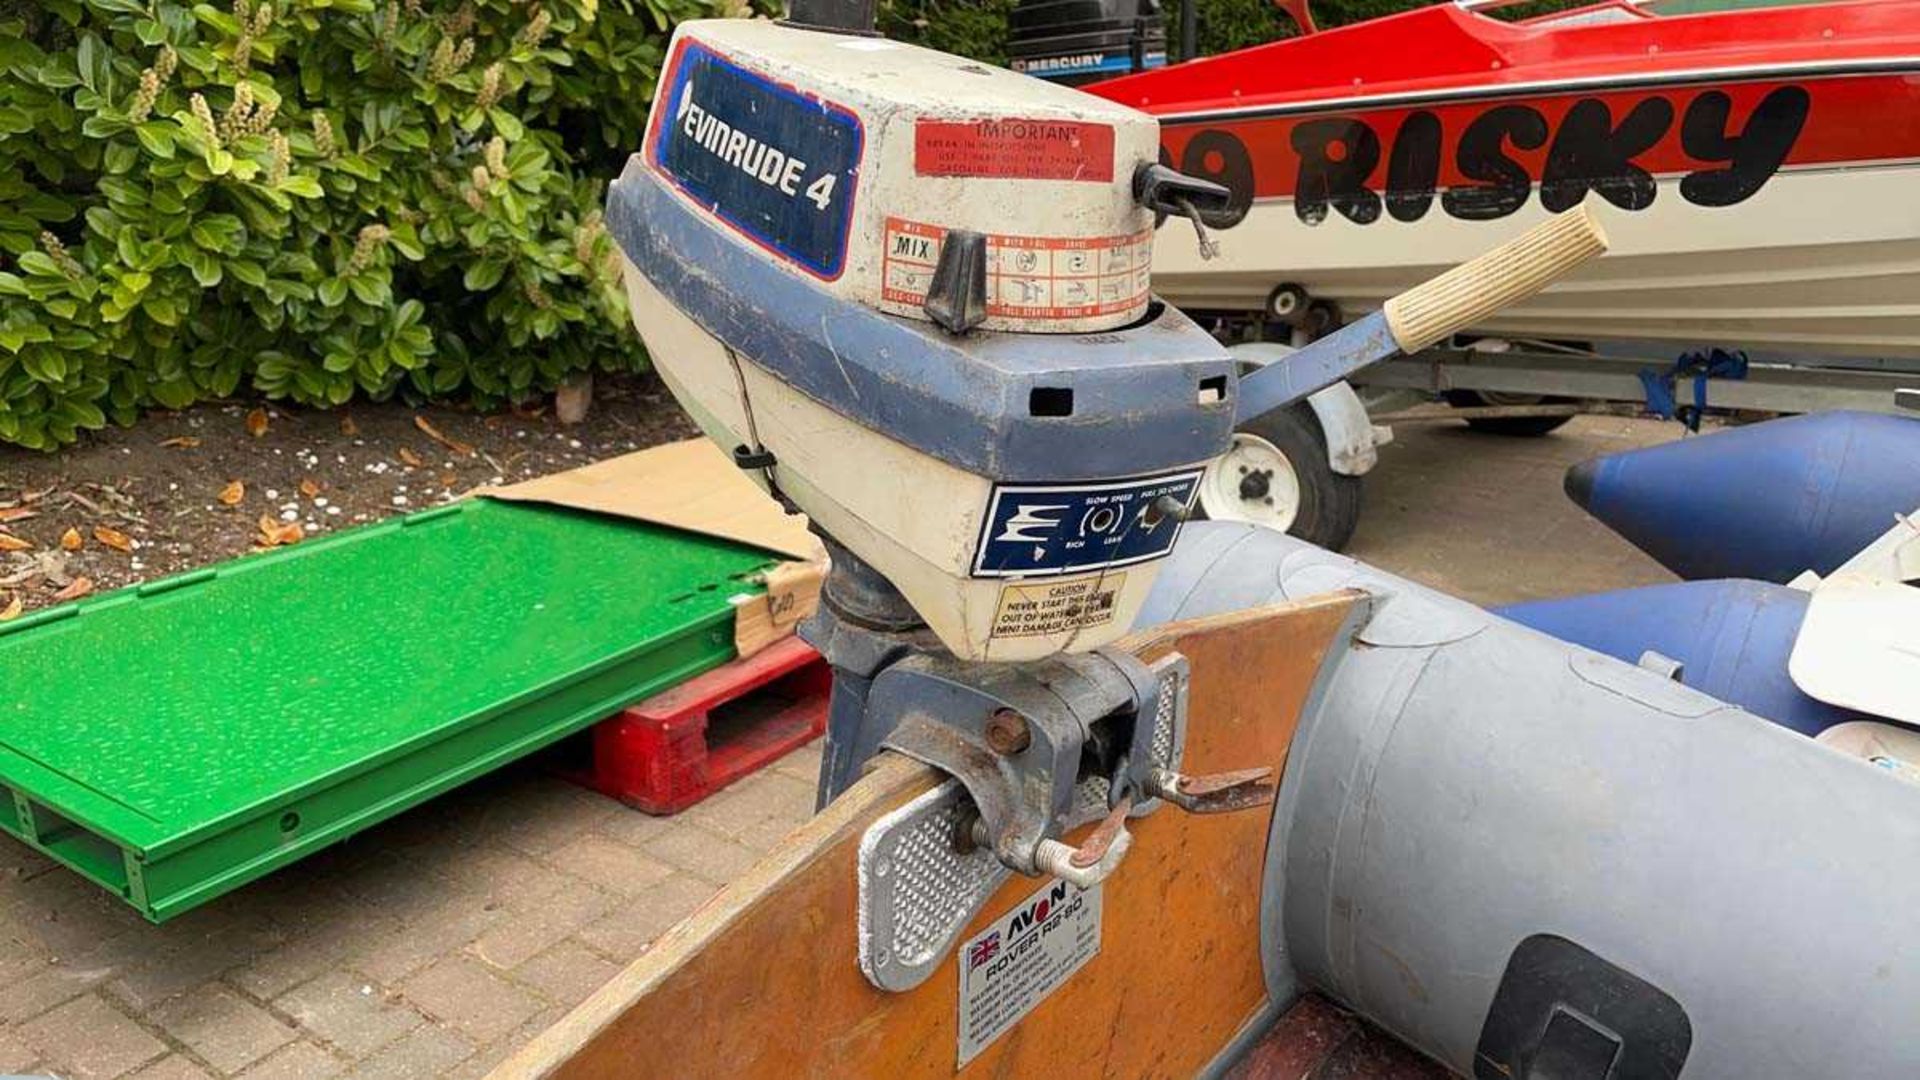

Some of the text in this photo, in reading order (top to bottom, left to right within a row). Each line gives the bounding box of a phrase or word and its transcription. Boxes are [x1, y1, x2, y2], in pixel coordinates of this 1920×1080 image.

[1028, 53, 1104, 72] MERCURY
[976, 123, 1078, 141] IMPORTANT
[684, 103, 837, 211] EVINRUDE 4
[1290, 85, 1811, 225] RISKY
[896, 236, 929, 259] MIX
[1086, 493, 1134, 506] SLOW SPEED
[1065, 540, 1086, 549] RICH
[1049, 583, 1087, 597] CAUTION
[1008, 601, 1038, 611] NEVER
[1041, 598, 1067, 609] START
[996, 623, 1020, 635] NENT
[1022, 619, 1062, 633] DAMAGE
[1064, 615, 1083, 628] CAN
[1001, 613, 1022, 624] OUT
[1024, 612, 1038, 622] OF
[1007, 880, 1066, 941] AVON
[985, 931, 1039, 982] ROVER
